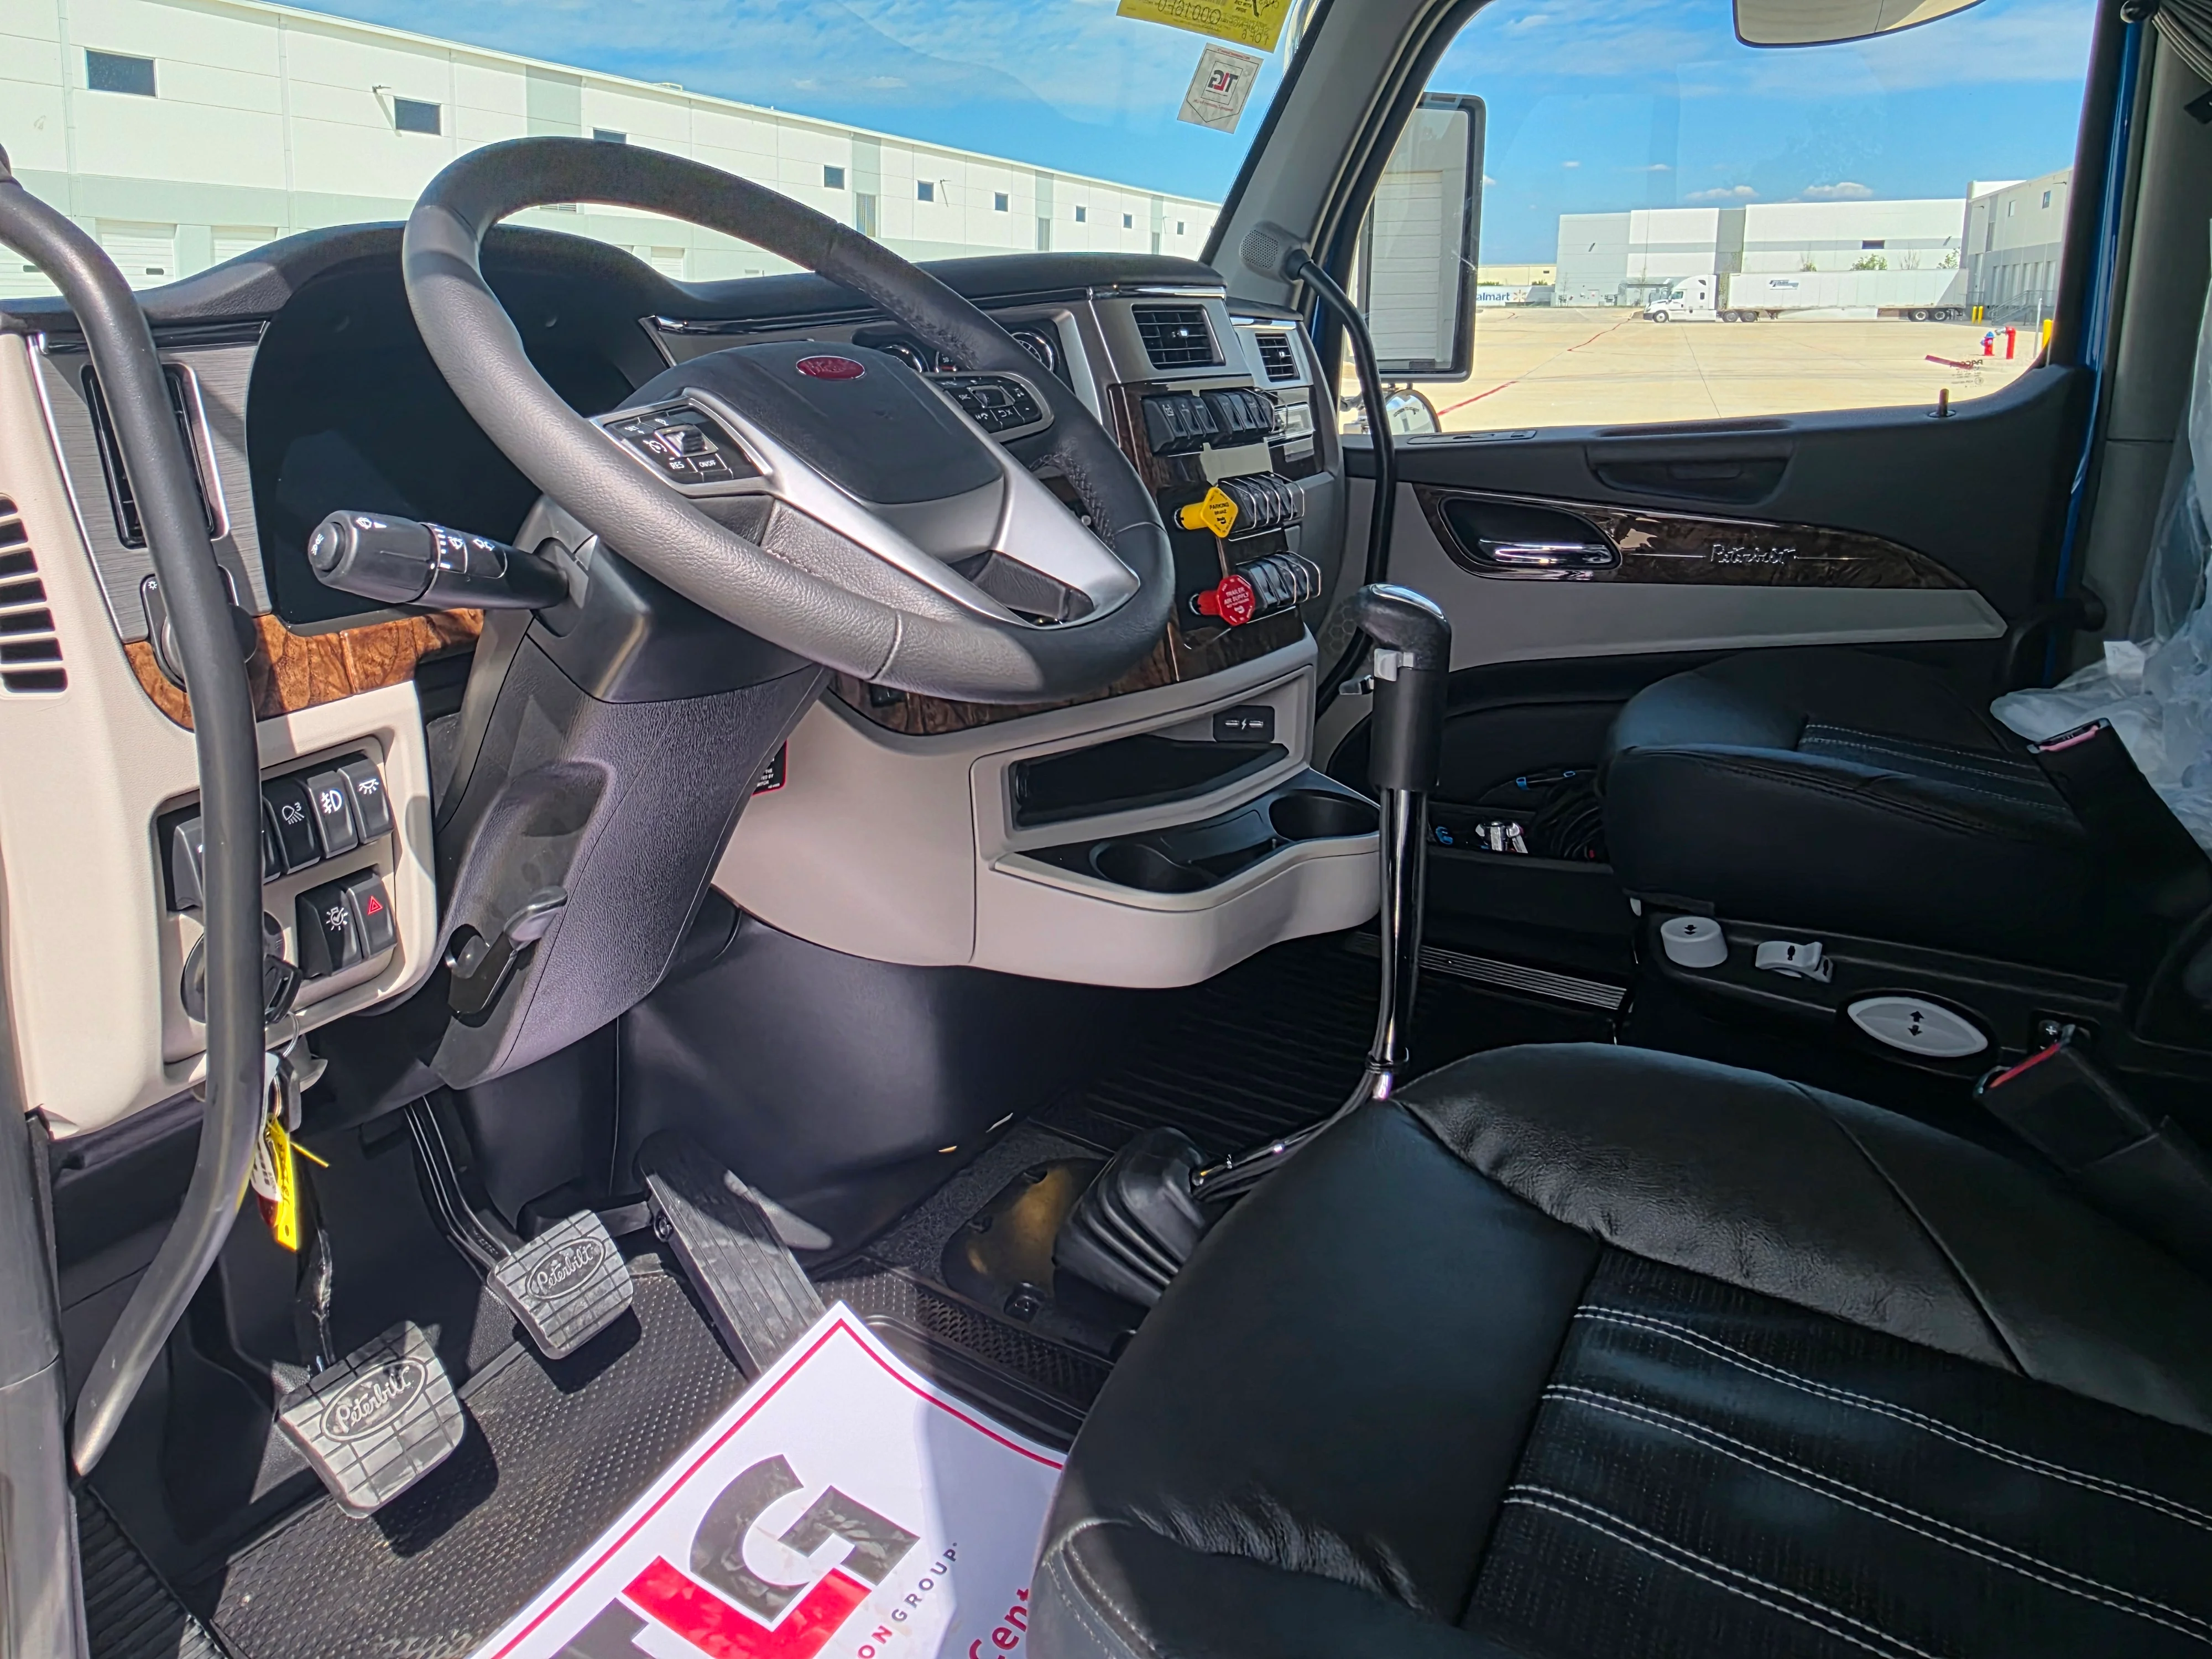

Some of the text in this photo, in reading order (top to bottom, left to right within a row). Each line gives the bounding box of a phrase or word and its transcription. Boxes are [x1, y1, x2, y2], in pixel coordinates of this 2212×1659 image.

[1477, 293, 1510, 301] almart
[669, 461, 685, 469] RES
[537, 1243, 593, 1295] Peterbilt
[336, 1365, 411, 1434] Peterbilt
[891, 1548, 957, 1622] GROUP
